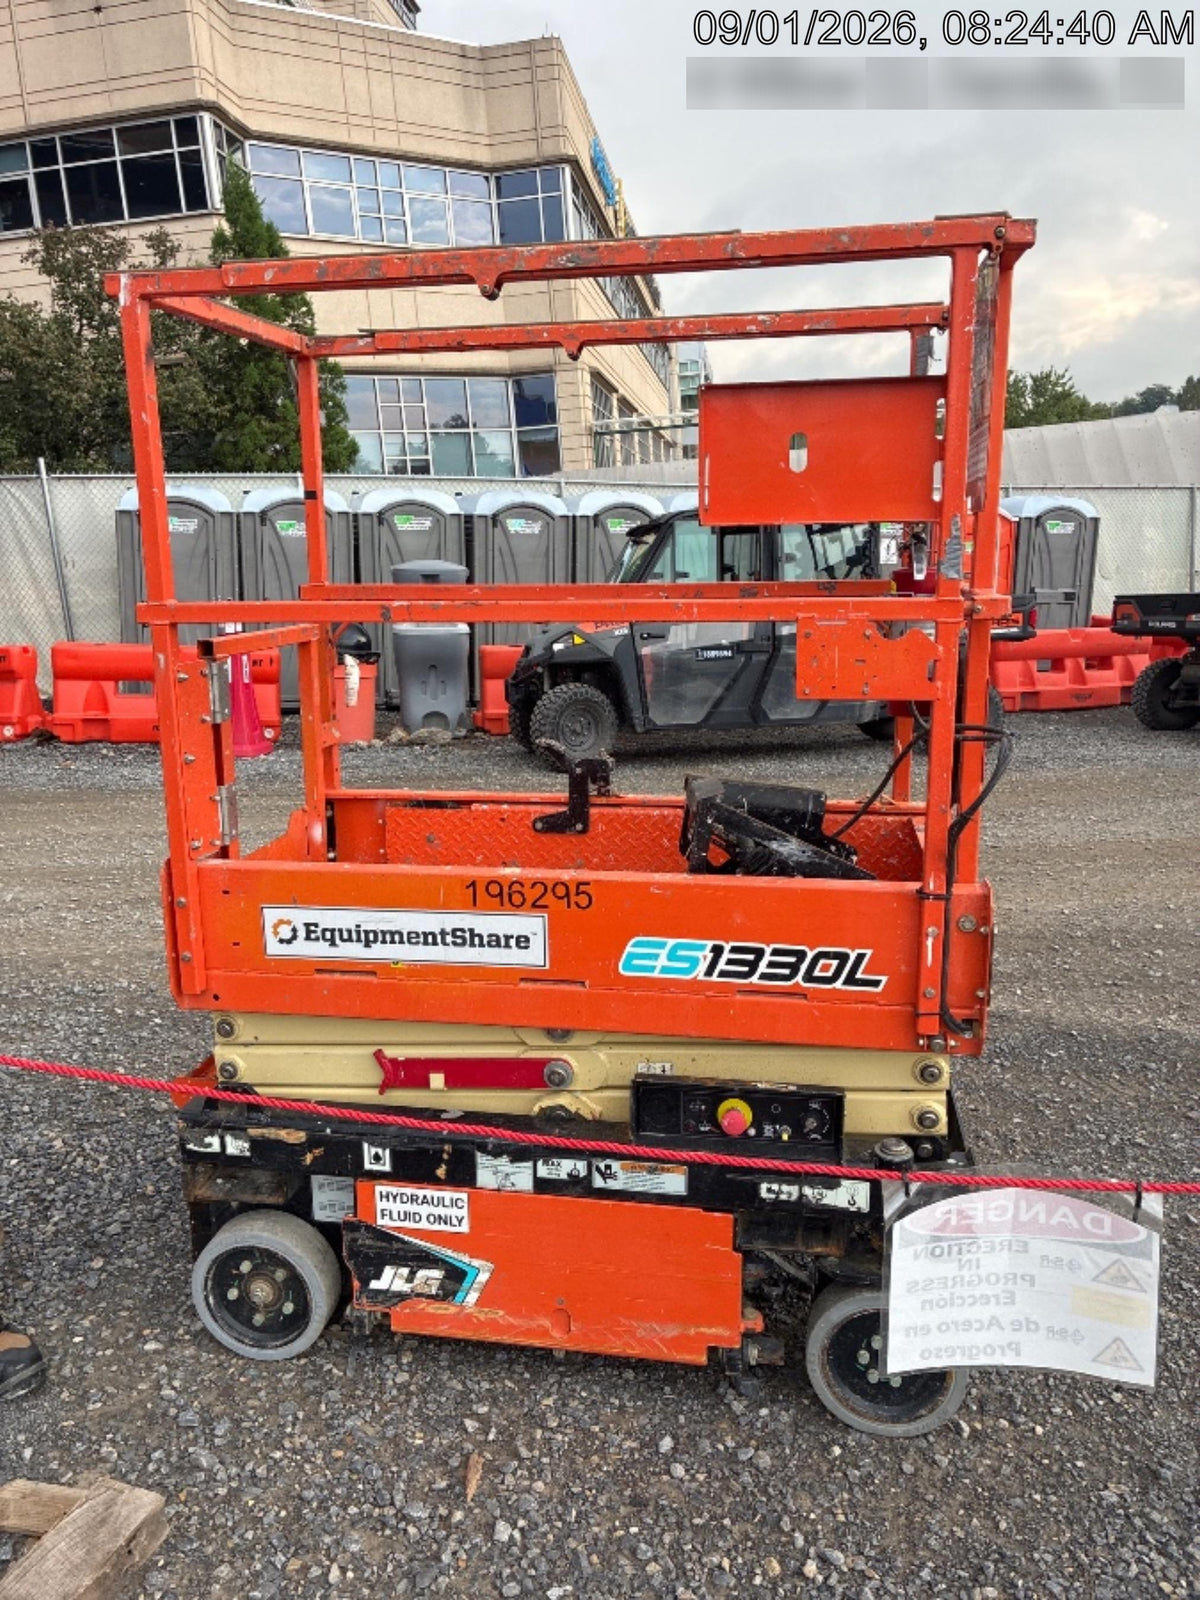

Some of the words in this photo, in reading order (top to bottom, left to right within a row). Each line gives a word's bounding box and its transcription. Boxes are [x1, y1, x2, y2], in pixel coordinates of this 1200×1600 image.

[465, 879, 594, 911] 196295
[303, 921, 532, 951] EquipmentShare
[620, 937, 888, 991] ES1330L
[379, 1190, 466, 1211] HYDRAULIC
[380, 1209, 423, 1225] FLUID
[426, 1211, 465, 1228] ONLY
[368, 1265, 445, 1295] JLG
